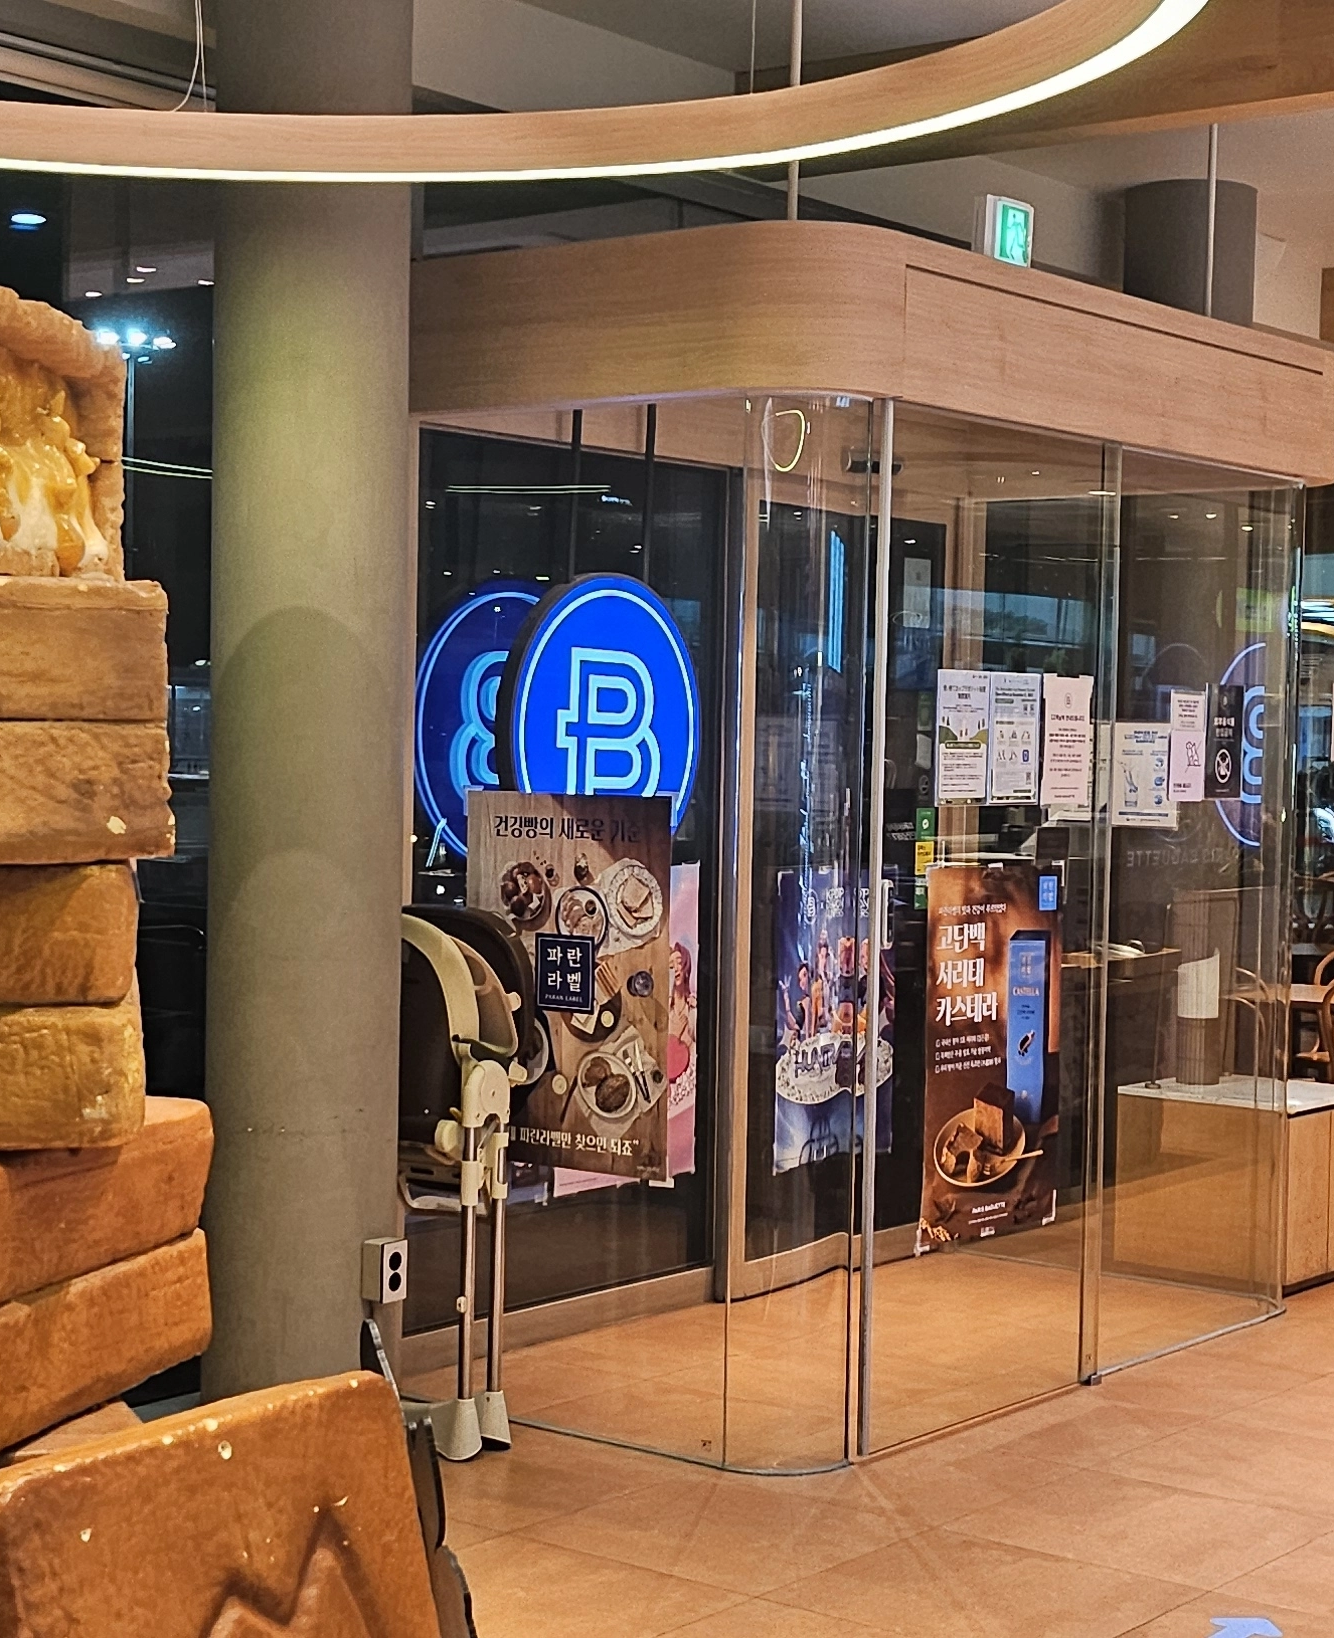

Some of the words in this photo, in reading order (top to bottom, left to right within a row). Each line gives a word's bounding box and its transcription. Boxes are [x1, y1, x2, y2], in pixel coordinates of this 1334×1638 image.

[559, 818, 604, 842] 새로운
[936, 921, 986, 953] 고단백
[546, 945, 583, 968] 파란
[547, 970, 582, 993] 라벨
[936, 957, 985, 990] 서리태
[935, 992, 999, 1027] 카스테라
